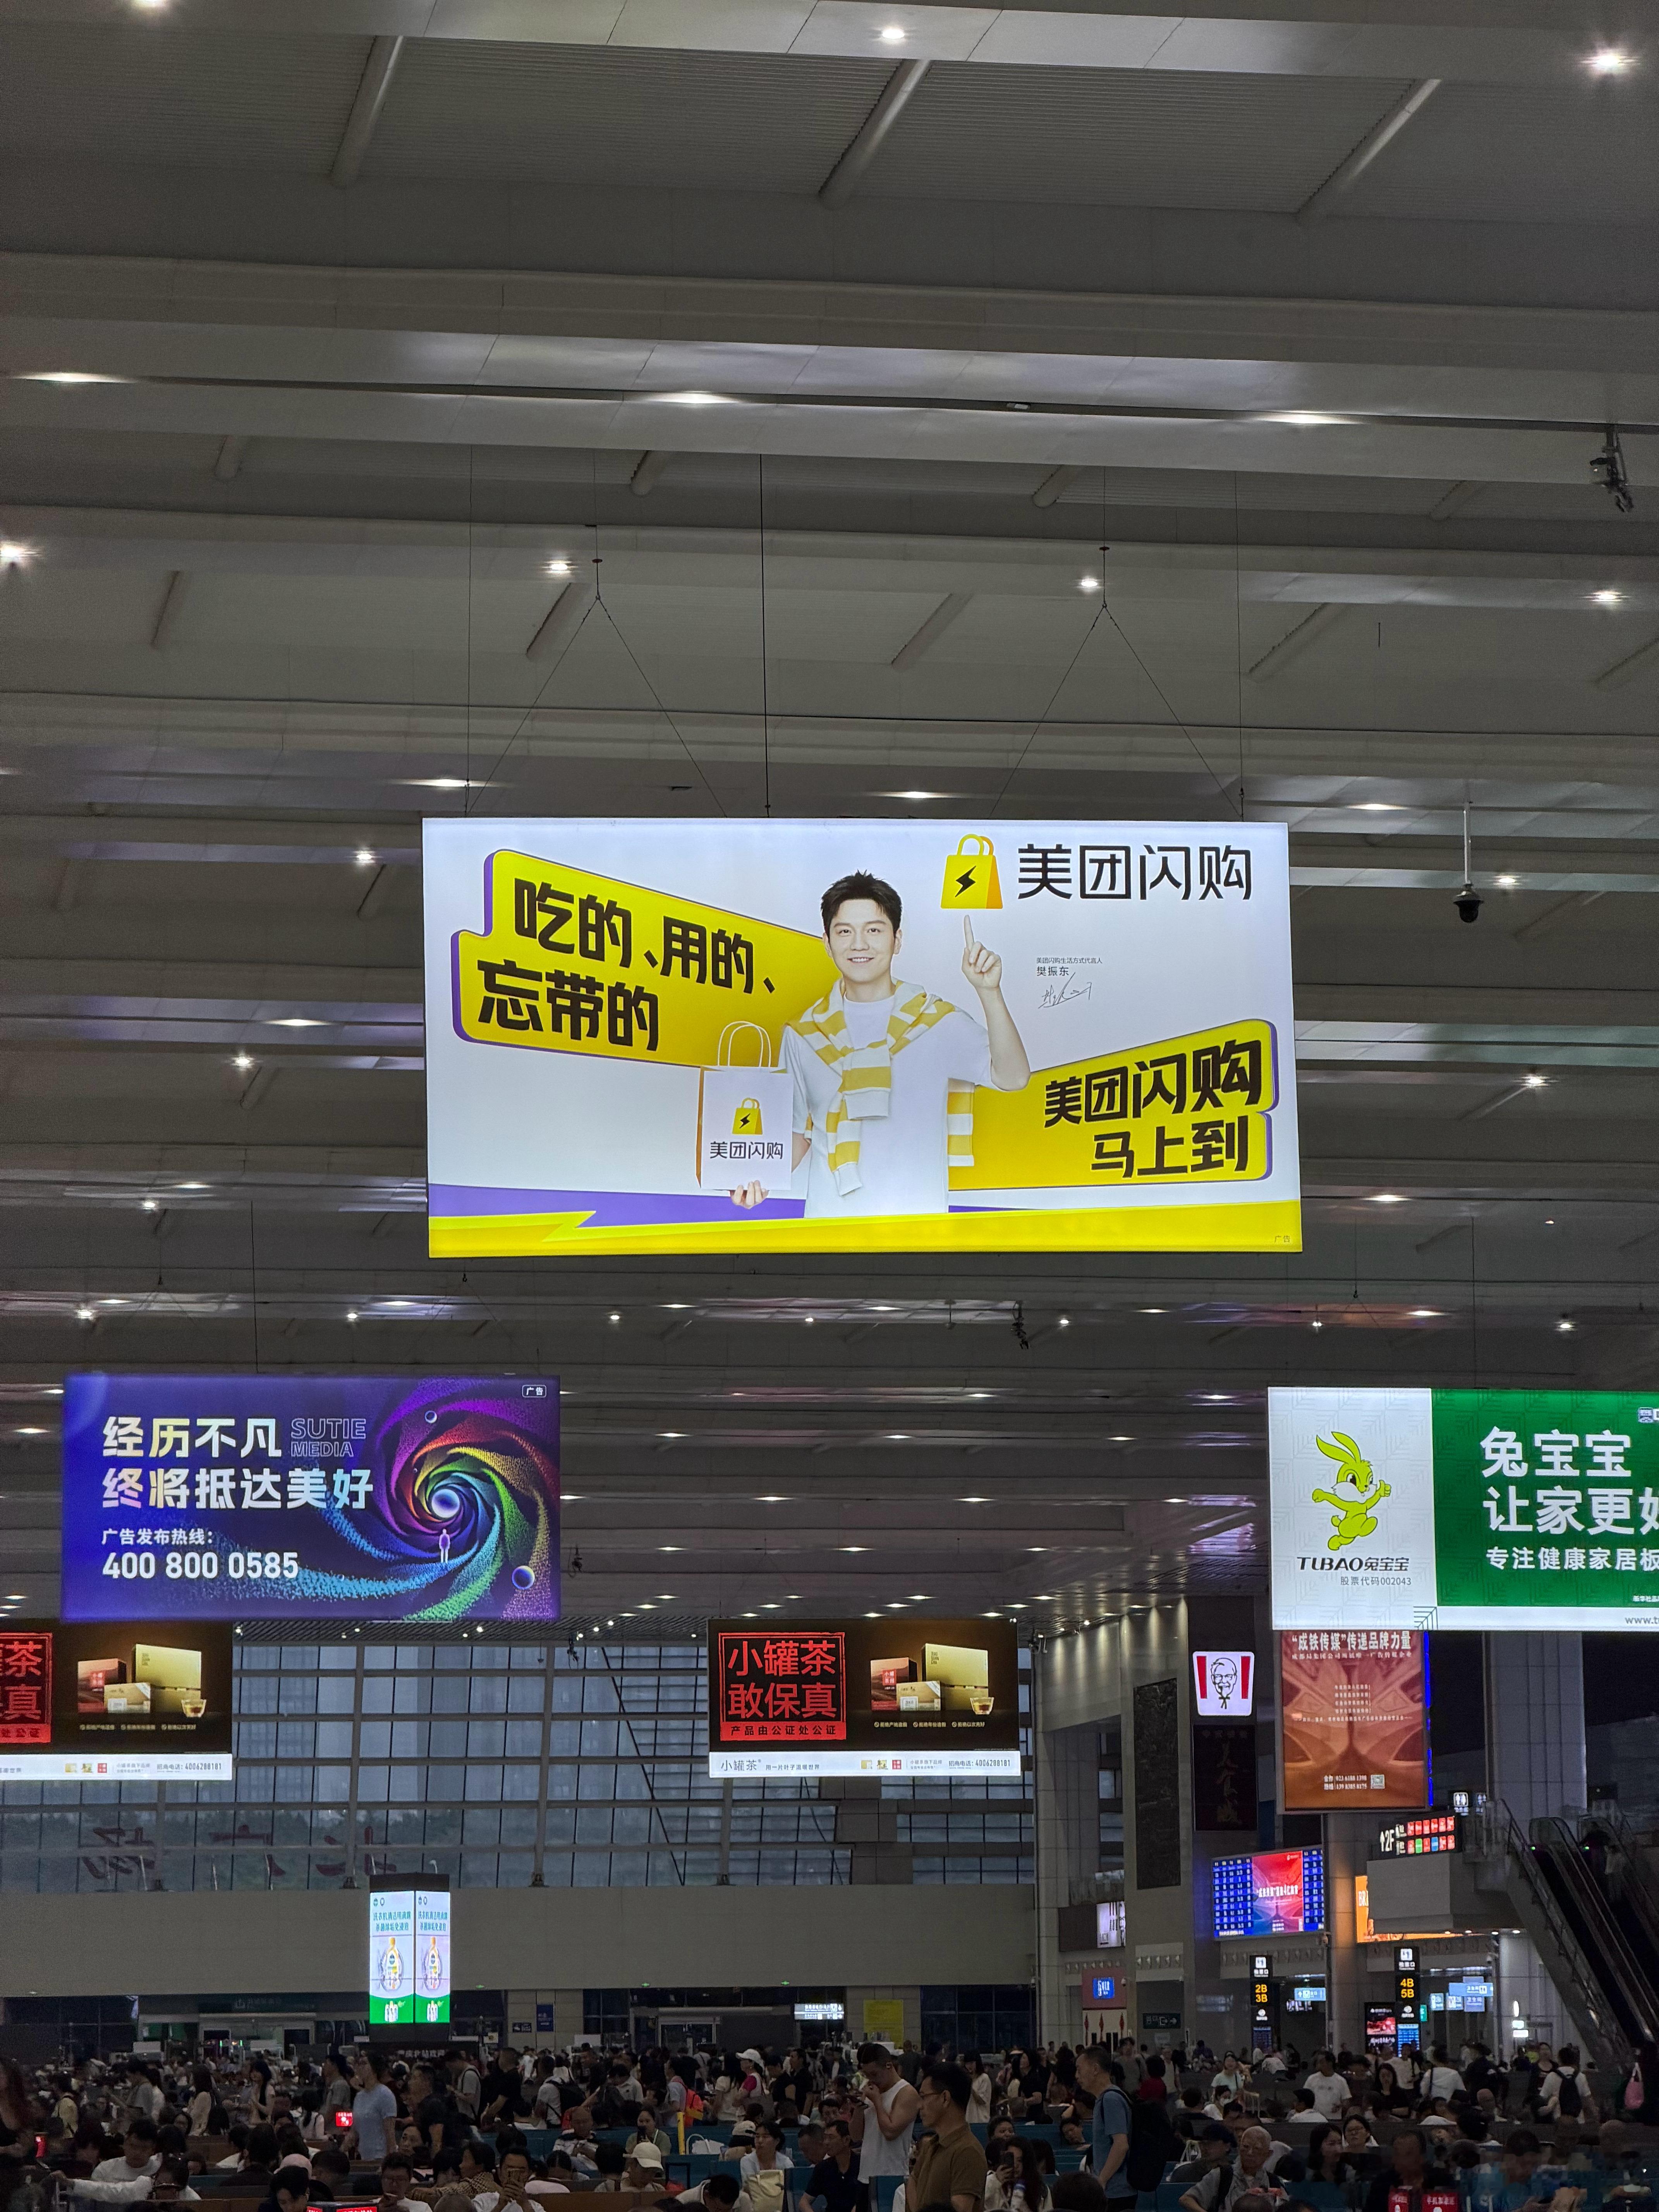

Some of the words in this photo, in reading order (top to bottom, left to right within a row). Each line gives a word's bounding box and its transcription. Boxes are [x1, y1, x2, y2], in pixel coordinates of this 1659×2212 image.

[1017, 843, 1251, 901] 美团闪购
[514, 878, 775, 994] 吃的、用的、
[1037, 966, 1069, 976] 樊振东
[477, 959, 659, 1052] 忘带的
[1044, 1039, 1262, 1128] 美团闪购
[710, 1141, 783, 1160] 美团闪购
[1091, 1115, 1249, 1178] 马上到
[1274, 1235, 1291, 1243] 广告
[526, 1386, 543, 1396] 广告
[102, 1416, 282, 1458] 经历不凡
[290, 1418, 366, 1439] SUTIE
[290, 1442, 354, 1457] MEDIA
[1480, 1426, 1632, 1478] 兔宝宝
[102, 1468, 374, 1509] 终将抵达美好
[102, 1552, 156, 1579] 400
[166, 1552, 218, 1579] 800
[228, 1552, 299, 1579] 0585
[1625, 1616, 1659, 1624] www.t
[1292, 1631, 1411, 1651] “成铁传媒”传递品牌力量
[0, 1641, 42, 1677] 茶
[728, 1640, 836, 1676] 小罐茶
[0, 1683, 41, 1719] 真
[728, 1682, 836, 1719] 敢保真
[731, 1725, 836, 1736] 产品由公证处公证
[1255, 1984, 1267, 1993] 2B
[1400, 1978, 1414, 1987] 4B
[1401, 1989, 1414, 1998] 5B
[1256, 1994, 1267, 2002] 3B
